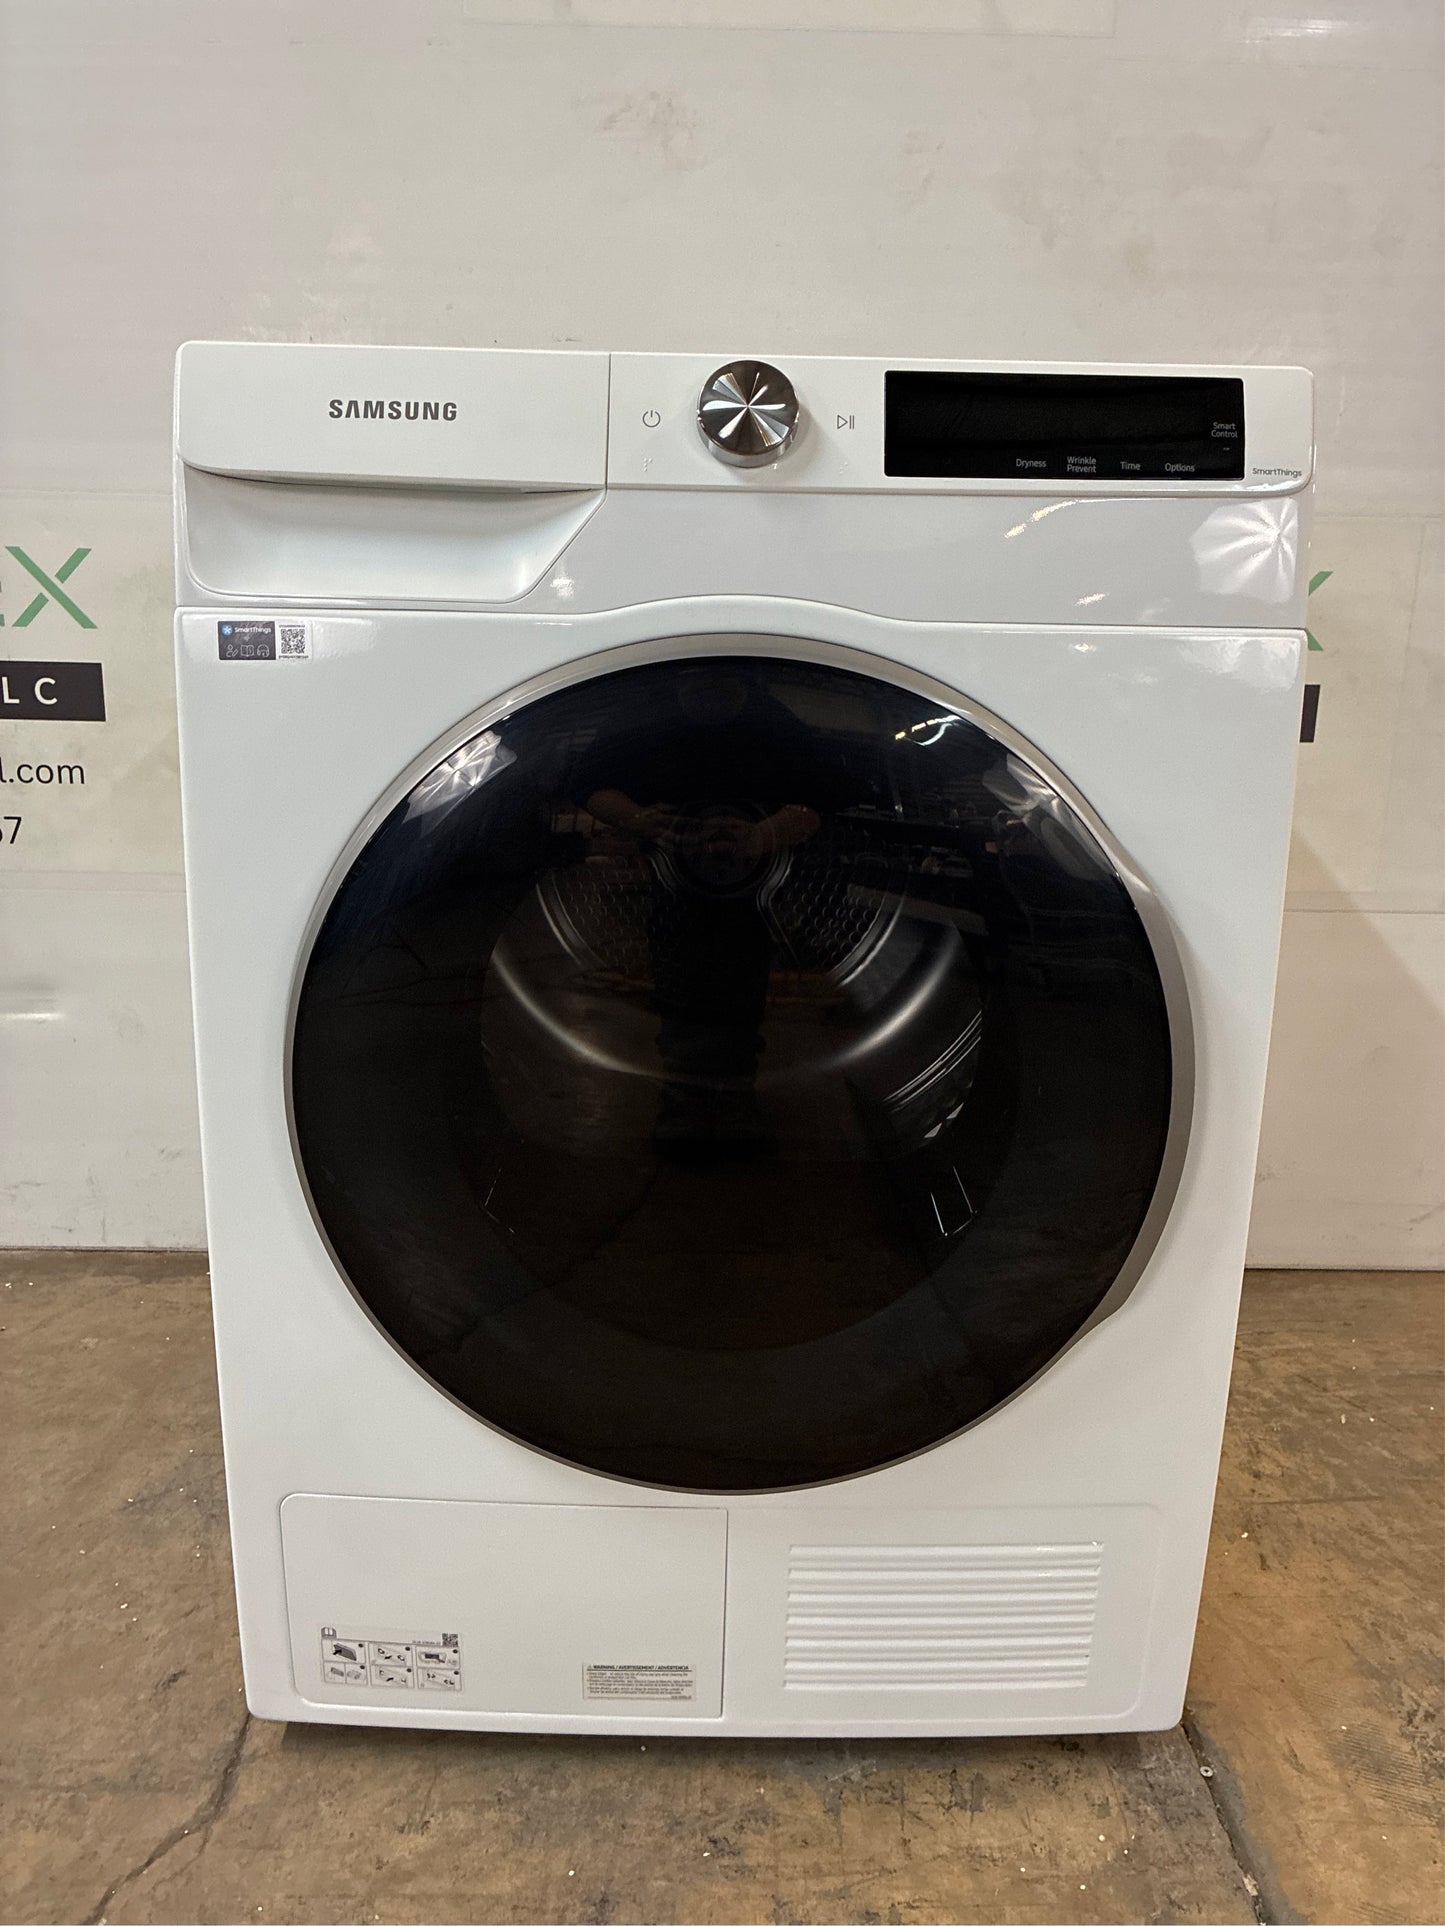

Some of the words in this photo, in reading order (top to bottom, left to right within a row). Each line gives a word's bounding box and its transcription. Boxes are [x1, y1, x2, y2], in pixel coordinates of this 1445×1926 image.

[328, 399, 457, 421] SAMSUNG
[1212, 422, 1236, 430] Smart
[1210, 430, 1238, 439] Control
[1015, 458, 1047, 469] Dryness
[1067, 456, 1097, 465] Wrinkle
[1066, 464, 1097, 473] Prevent
[1120, 461, 1141, 471] Time
[1164, 462, 1195, 473] Options
[1252, 467, 1302, 478] SmartThings
[0, 545, 98, 629] X
[234, 626, 272, 635] SmartThings
